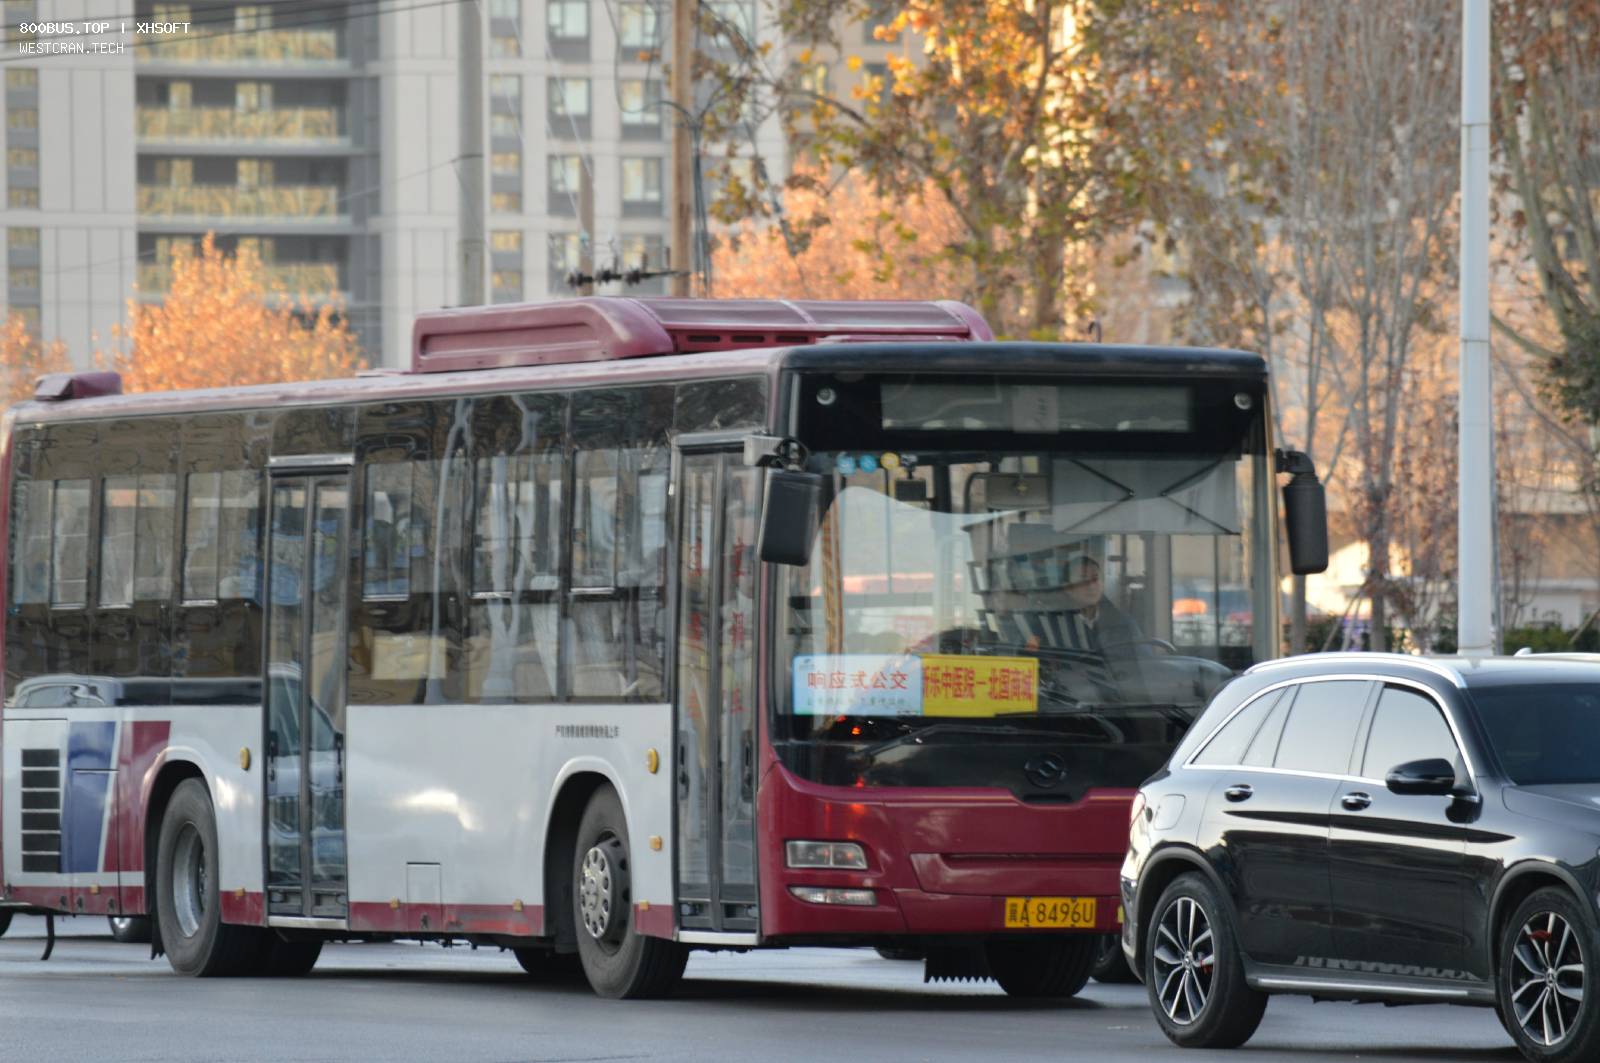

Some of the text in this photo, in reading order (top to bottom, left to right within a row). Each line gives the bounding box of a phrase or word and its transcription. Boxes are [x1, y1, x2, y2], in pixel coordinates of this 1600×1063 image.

[807, 671, 909, 690] 响应式公交
